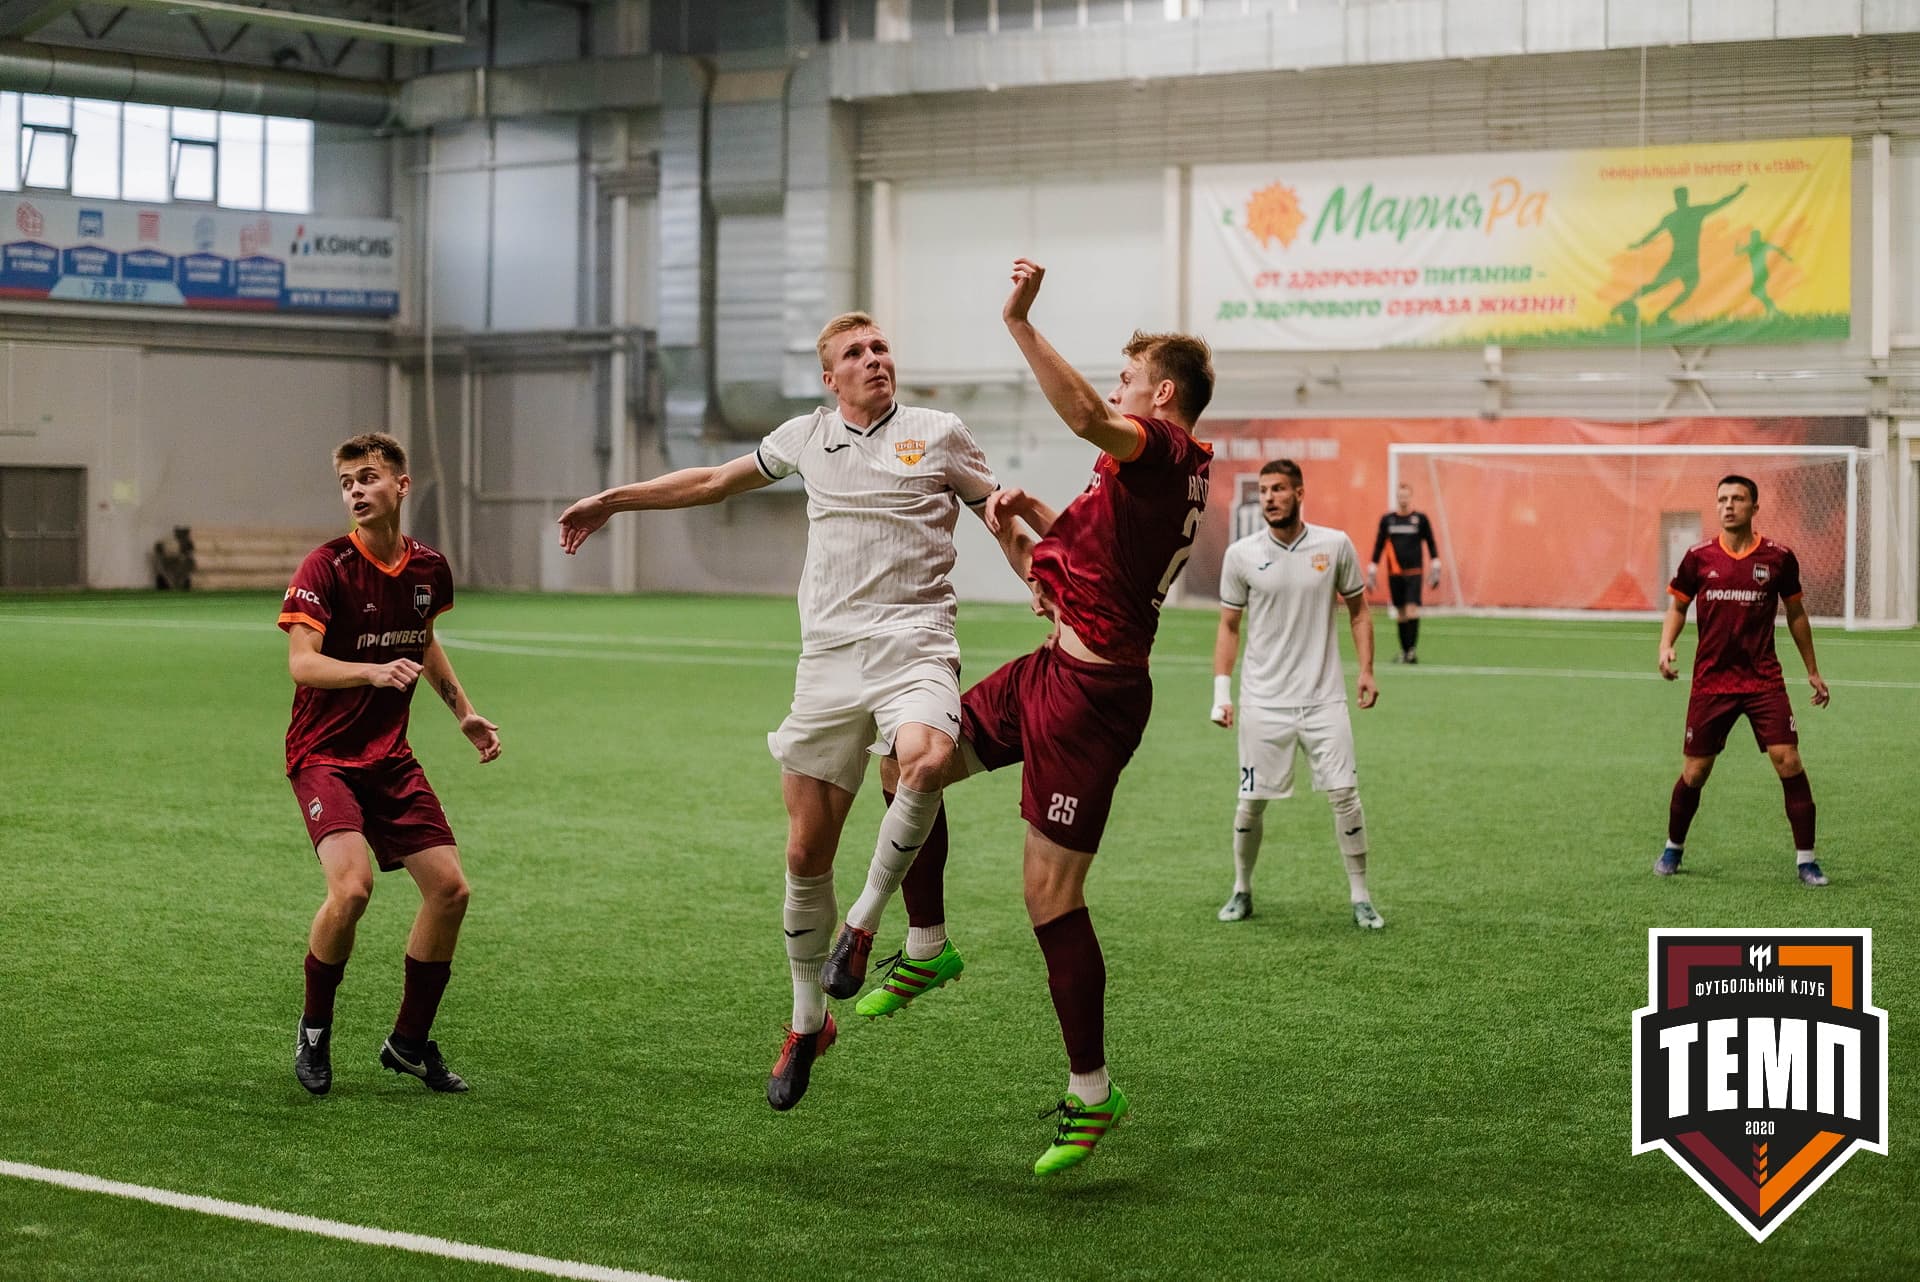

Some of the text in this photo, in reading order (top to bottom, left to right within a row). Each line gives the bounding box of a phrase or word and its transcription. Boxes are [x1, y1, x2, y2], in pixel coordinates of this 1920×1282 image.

[1255, 270, 1281, 289] ОТ
[1287, 267, 1419, 291] ЗДОРОВОГО
[1423, 265, 1533, 285] ПИТАНИЯ
[1217, 300, 1248, 321] ДО
[1252, 300, 1382, 321] ЗДОРОВОГО
[1387, 298, 1472, 317] ОБРАЗА
[1241, 766, 1254, 791] 21
[1047, 792, 1078, 825] 25
